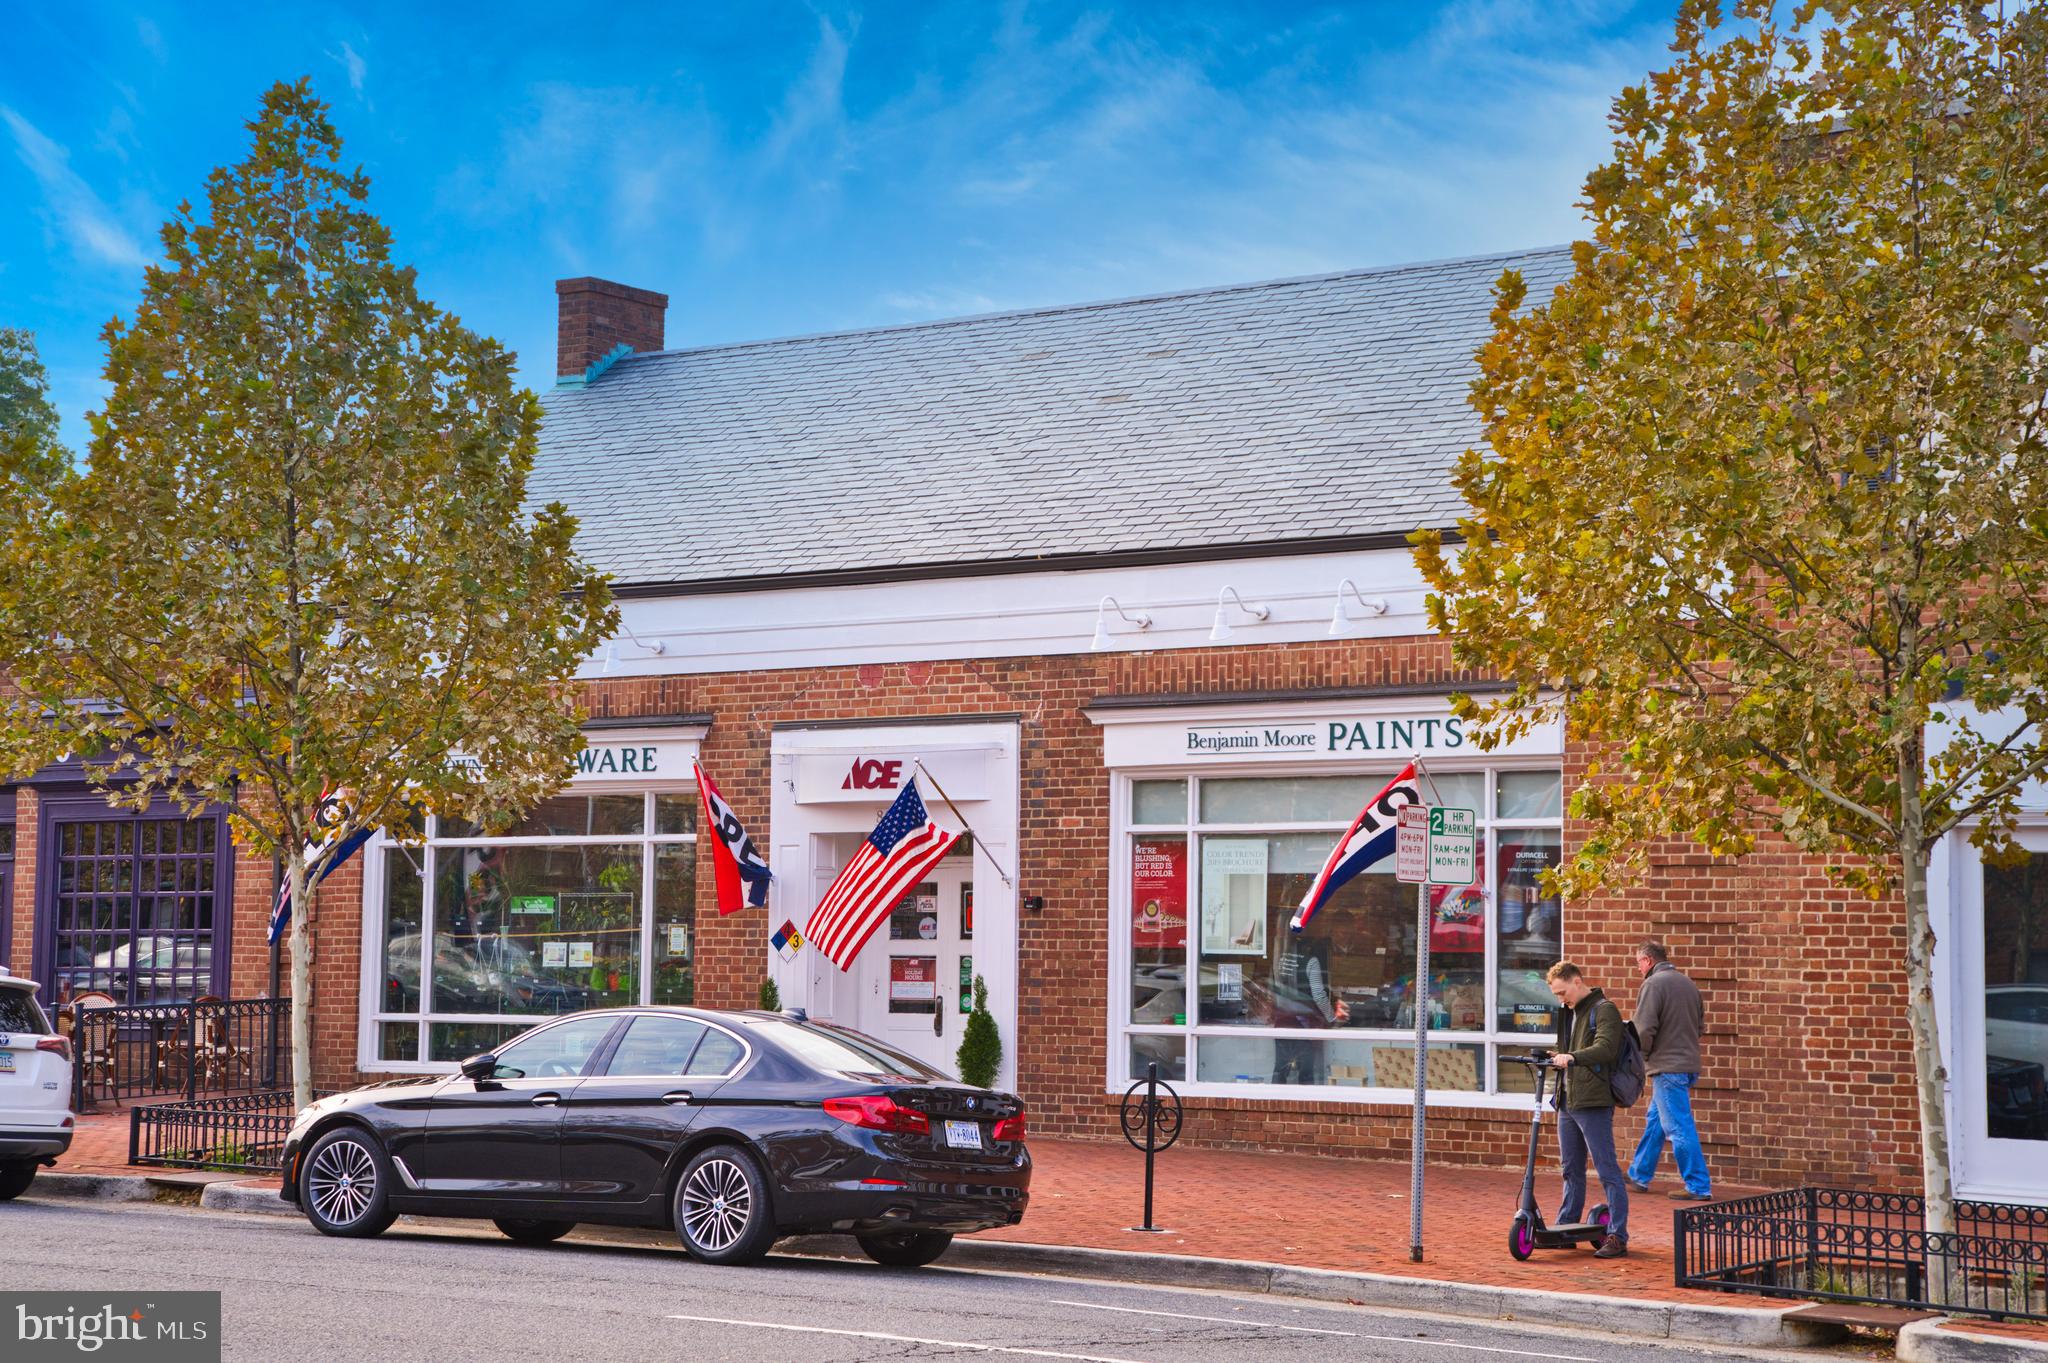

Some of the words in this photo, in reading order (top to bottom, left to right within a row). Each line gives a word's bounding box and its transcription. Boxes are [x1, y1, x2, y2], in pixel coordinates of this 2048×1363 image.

[1187, 730, 1258, 752] Benjamin
[1264, 728, 1316, 747] Moore
[1327, 718, 1463, 751] PAINTS
[841, 756, 903, 790] ACE
[1407, 812, 1426, 823] PARKING
[1432, 812, 1442, 832] 2
[1452, 812, 1465, 822] HR
[1444, 823, 1473, 835] PARKING
[1400, 832, 1424, 842] 4PM-6PM
[1135, 846, 1157, 854] WE'RE
[1206, 850, 1233, 858] COLOR
[1235, 850, 1265, 858] TRENDS
[1401, 844, 1423, 854] MON-FRI
[1433, 844, 1471, 854] 9AM-4PM
[1135, 854, 1172, 863] BLUSHING,
[1515, 851, 1549, 859] DURACELL
[1135, 862, 1149, 870] BUT
[1150, 862, 1165, 870] RED
[1435, 857, 1469, 867] MON-FRI
[792, 934, 800, 948] 3
